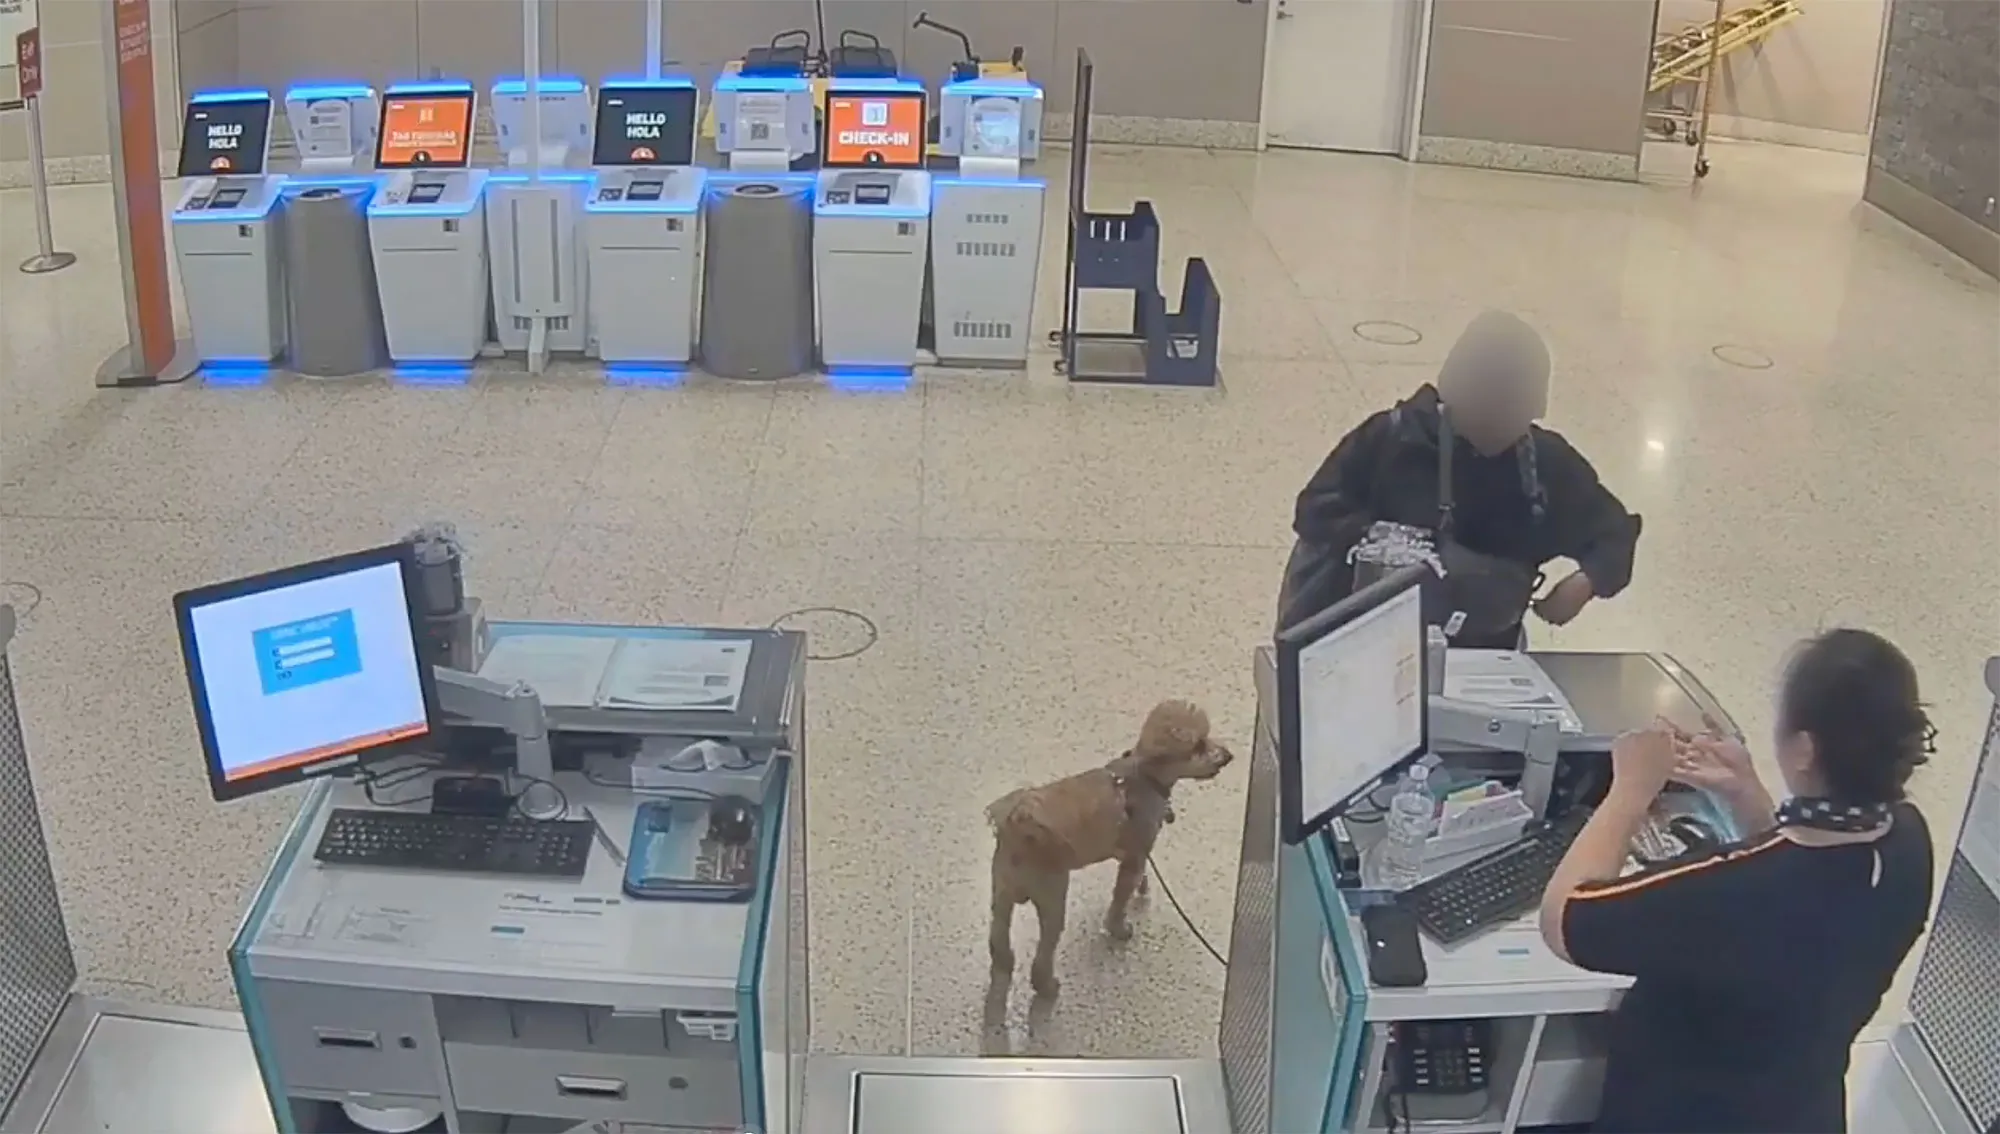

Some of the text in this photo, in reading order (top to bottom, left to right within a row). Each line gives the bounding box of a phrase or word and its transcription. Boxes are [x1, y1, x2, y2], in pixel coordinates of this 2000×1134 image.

[626, 112, 666, 125] HELLO
[208, 124, 243, 136] HELLO
[627, 126, 660, 138] HOLA
[208, 137, 238, 149] HOLA
[839, 130, 909, 146] CHECK-IN
